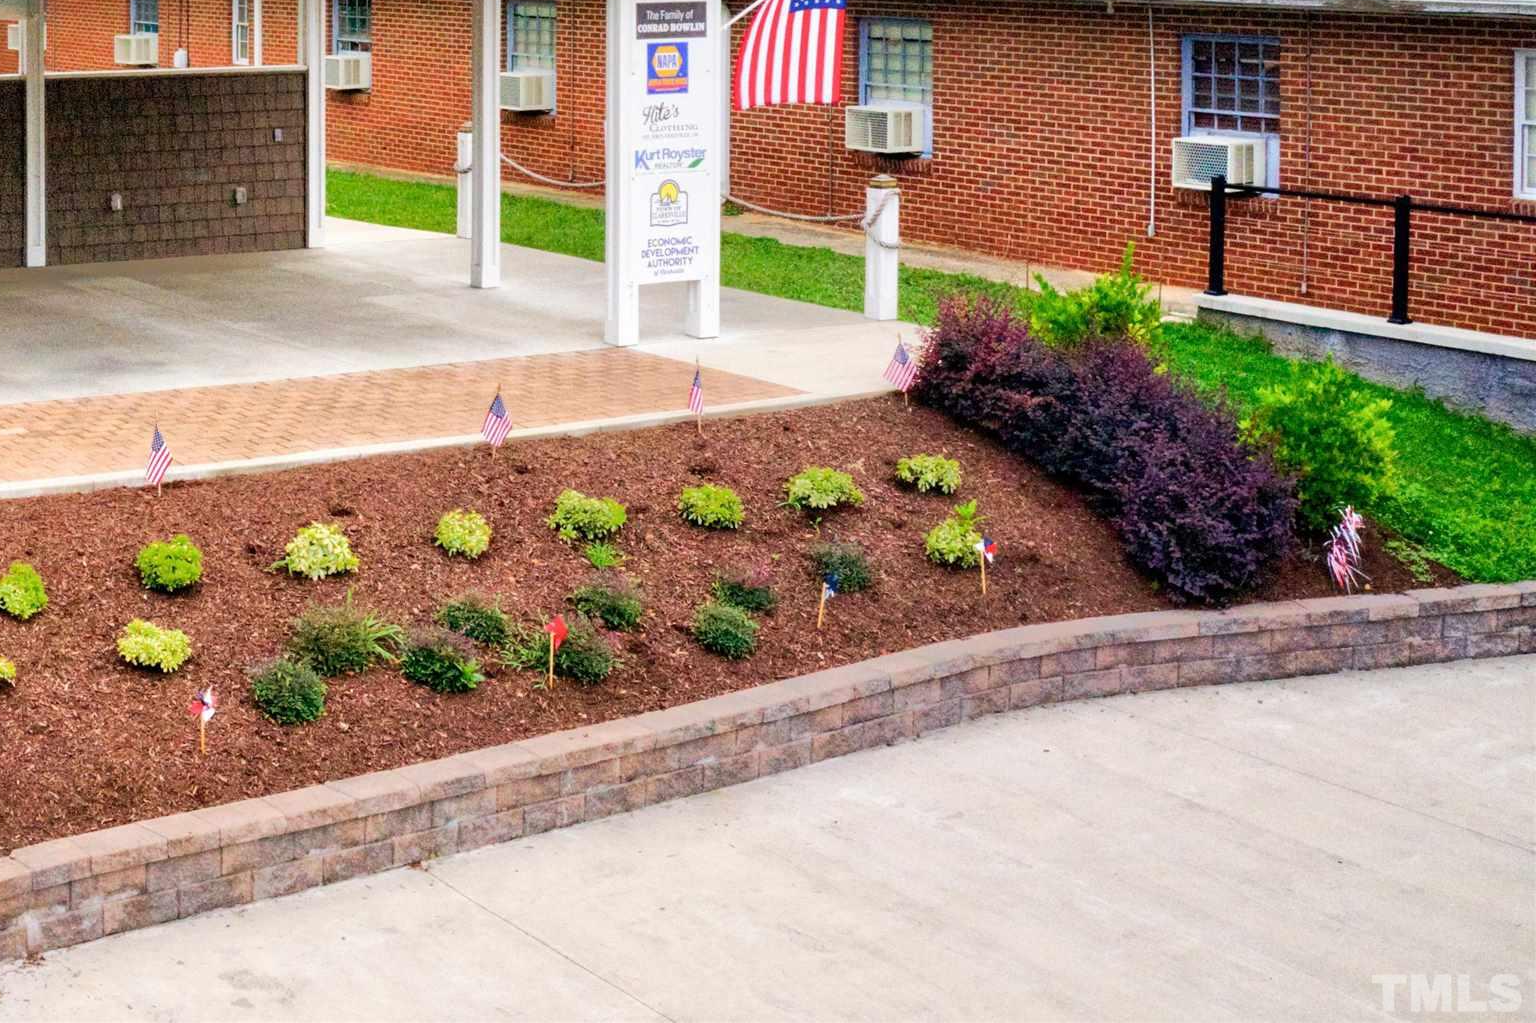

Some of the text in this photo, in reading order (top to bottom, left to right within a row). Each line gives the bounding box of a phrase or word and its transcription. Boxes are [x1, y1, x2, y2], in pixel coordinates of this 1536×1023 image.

[646, 8, 694, 22] The Family of
[637, 24, 669, 33] CONRAD
[657, 54, 677, 68] NAPA
[635, 147, 706, 170] Kurt Royster
[648, 236, 693, 248] ECONOMIC
[641, 246, 699, 258] DEVELOPMENT
[648, 256, 693, 268] AUTHORITY
